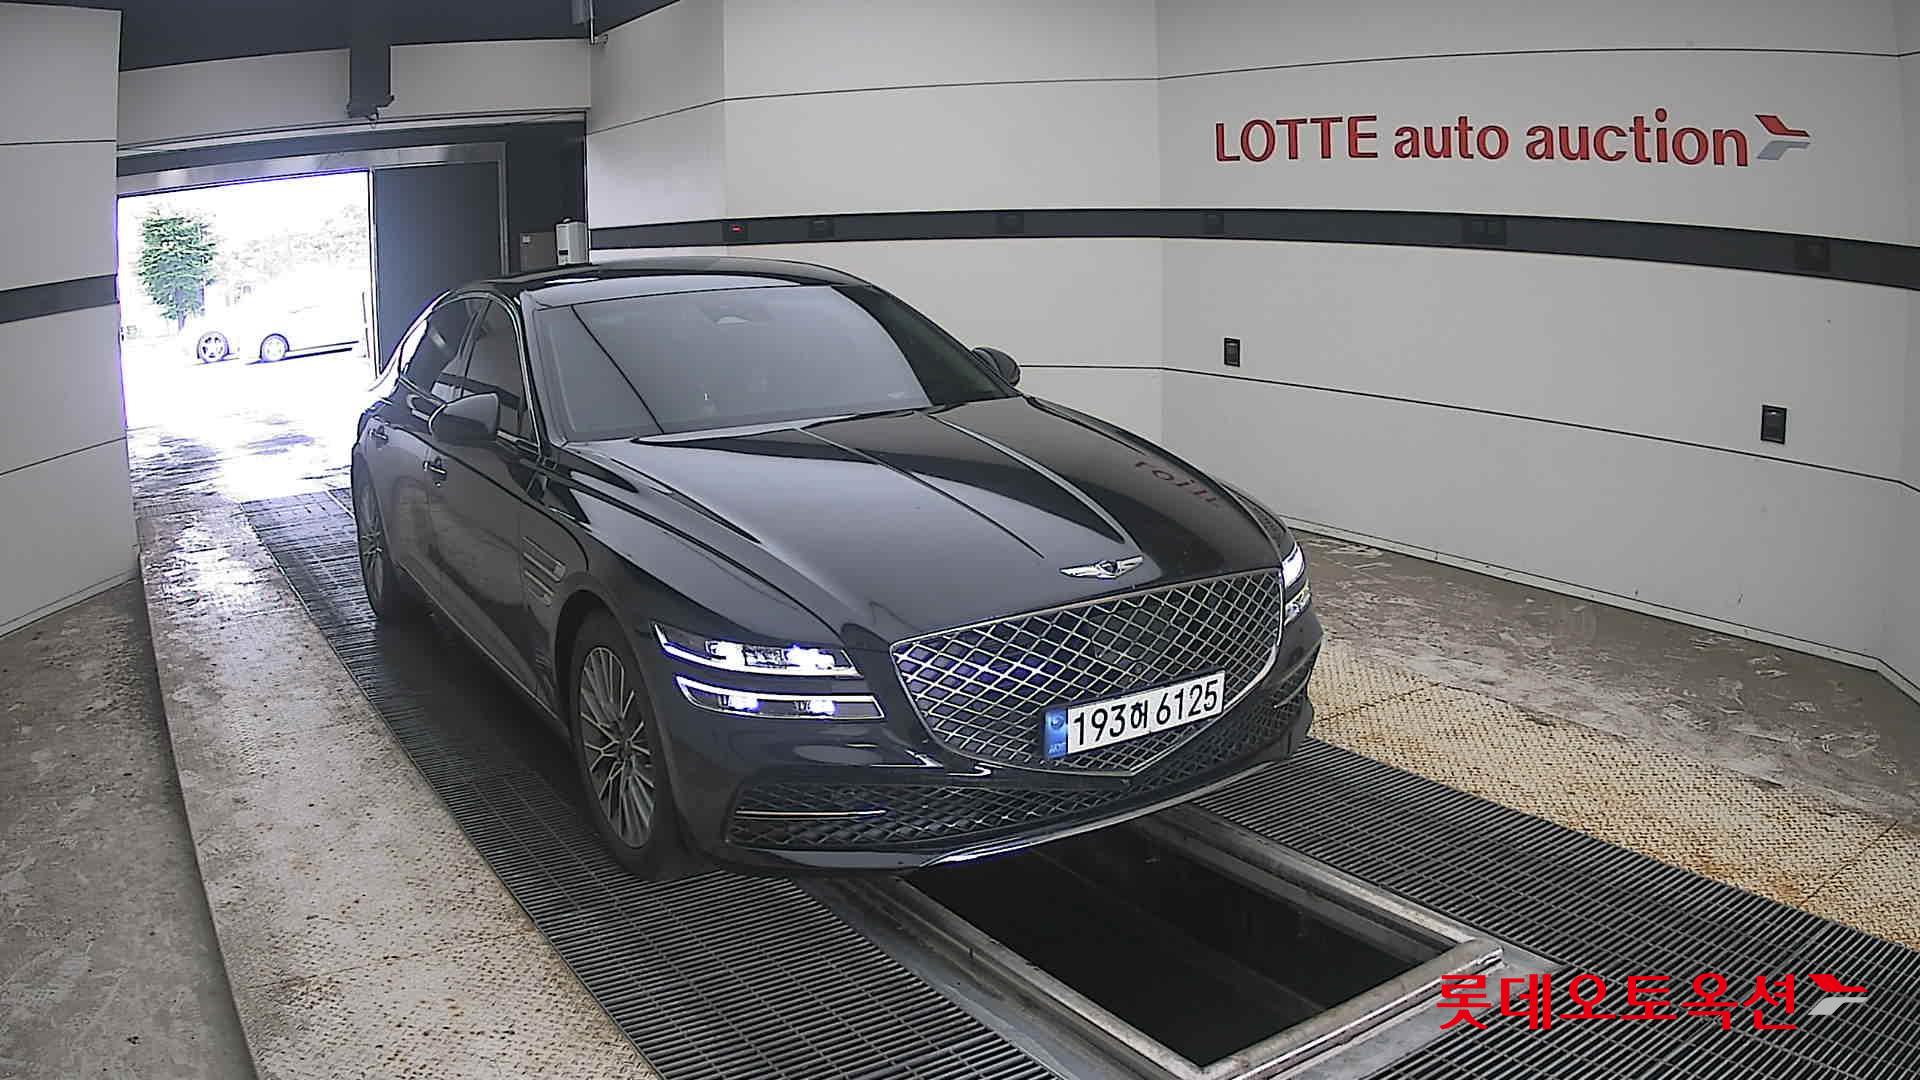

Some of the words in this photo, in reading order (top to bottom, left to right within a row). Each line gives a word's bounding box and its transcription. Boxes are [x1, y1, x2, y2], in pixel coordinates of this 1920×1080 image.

[1215, 115, 1378, 162] LOTTE
[1394, 115, 1509, 160] auto
[1525, 107, 1749, 167] auction
[1073, 700, 1149, 746] 193허
[1156, 679, 1219, 726] 6125
